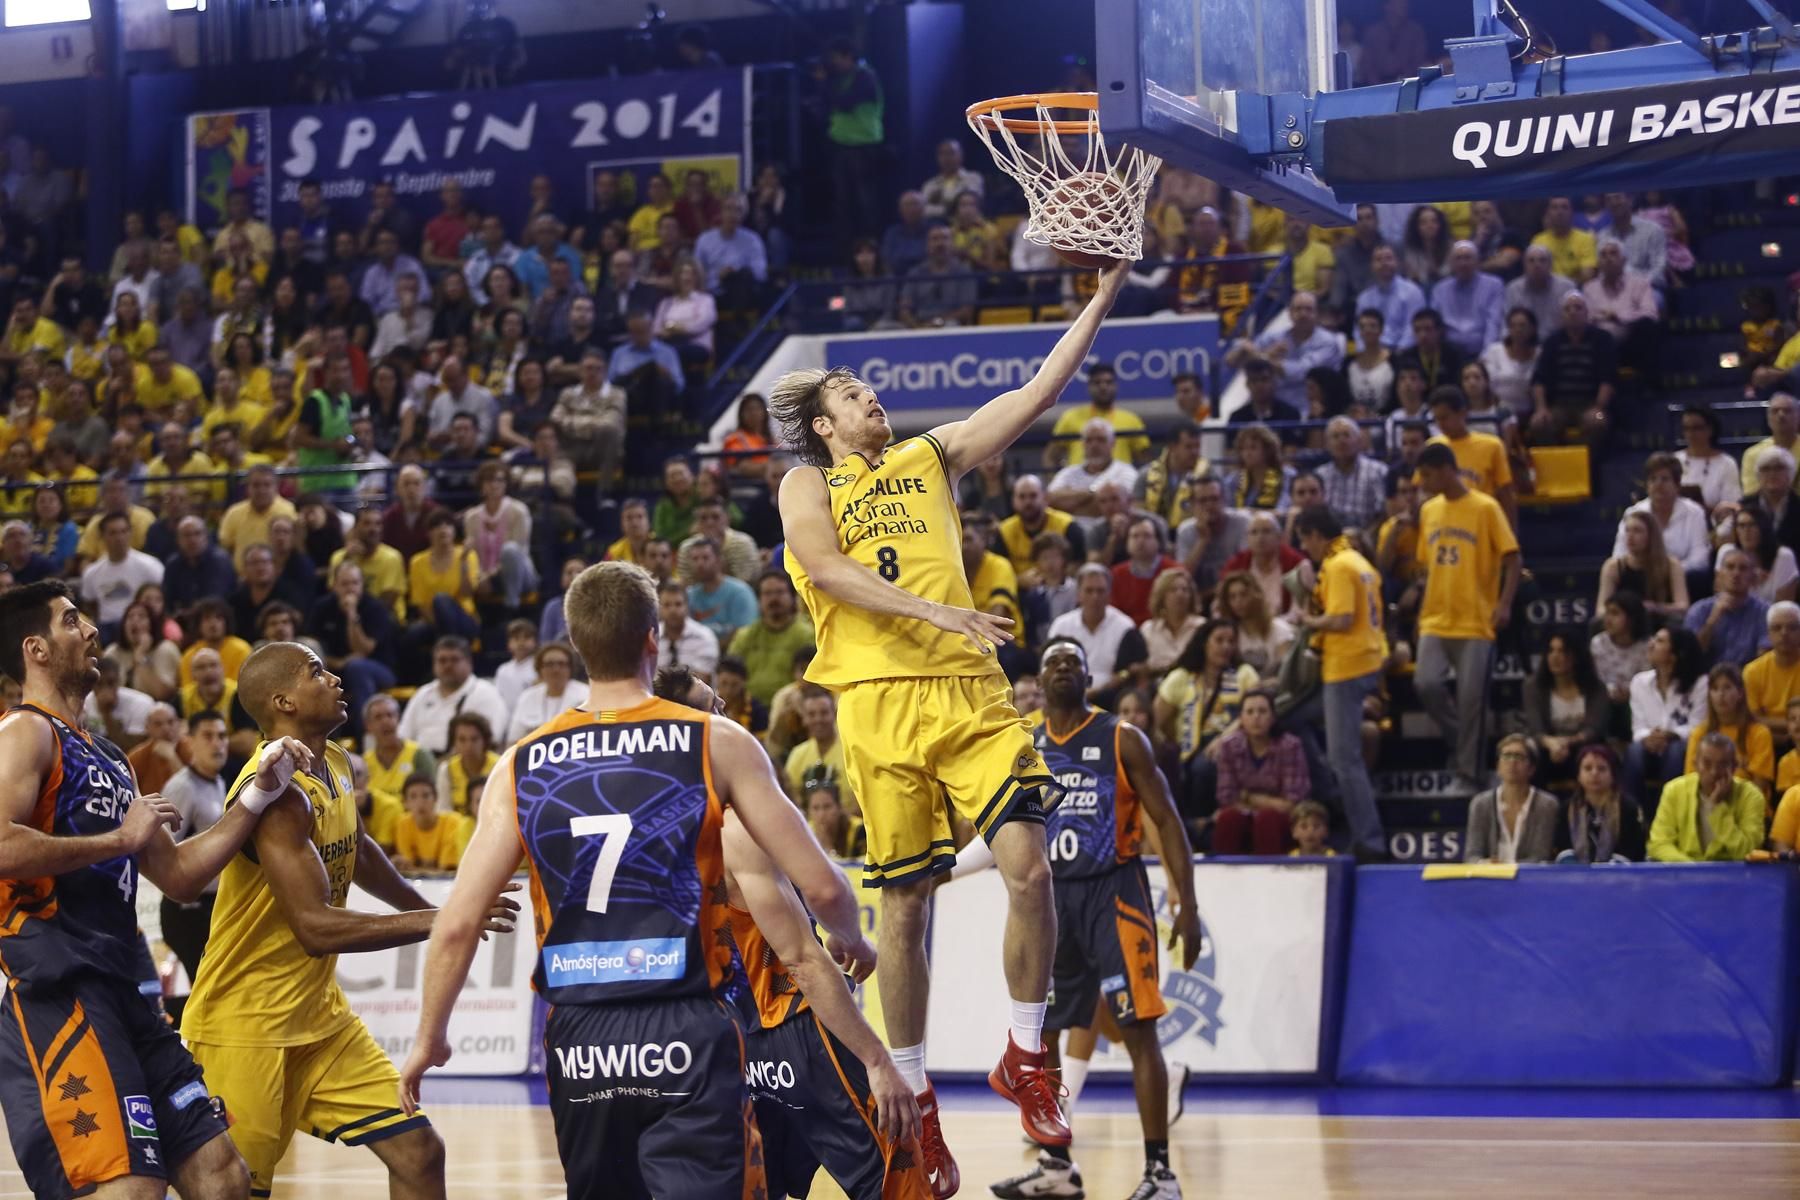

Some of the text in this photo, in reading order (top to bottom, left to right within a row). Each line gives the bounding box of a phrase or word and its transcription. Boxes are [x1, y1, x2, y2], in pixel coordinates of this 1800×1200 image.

[570, 88, 722, 147] 2014
[1452, 85, 1800, 169] QUINI BASKE
[845, 514, 929, 545] Canaria
[854, 501, 906, 523] Gran
[877, 546, 899, 582] 8
[528, 724, 691, 771] DOELLMAN
[569, 813, 633, 914] 7
[1050, 829, 1078, 861] 10
[118, 859, 132, 903] 4
[551, 953, 624, 977] Atmósfera
